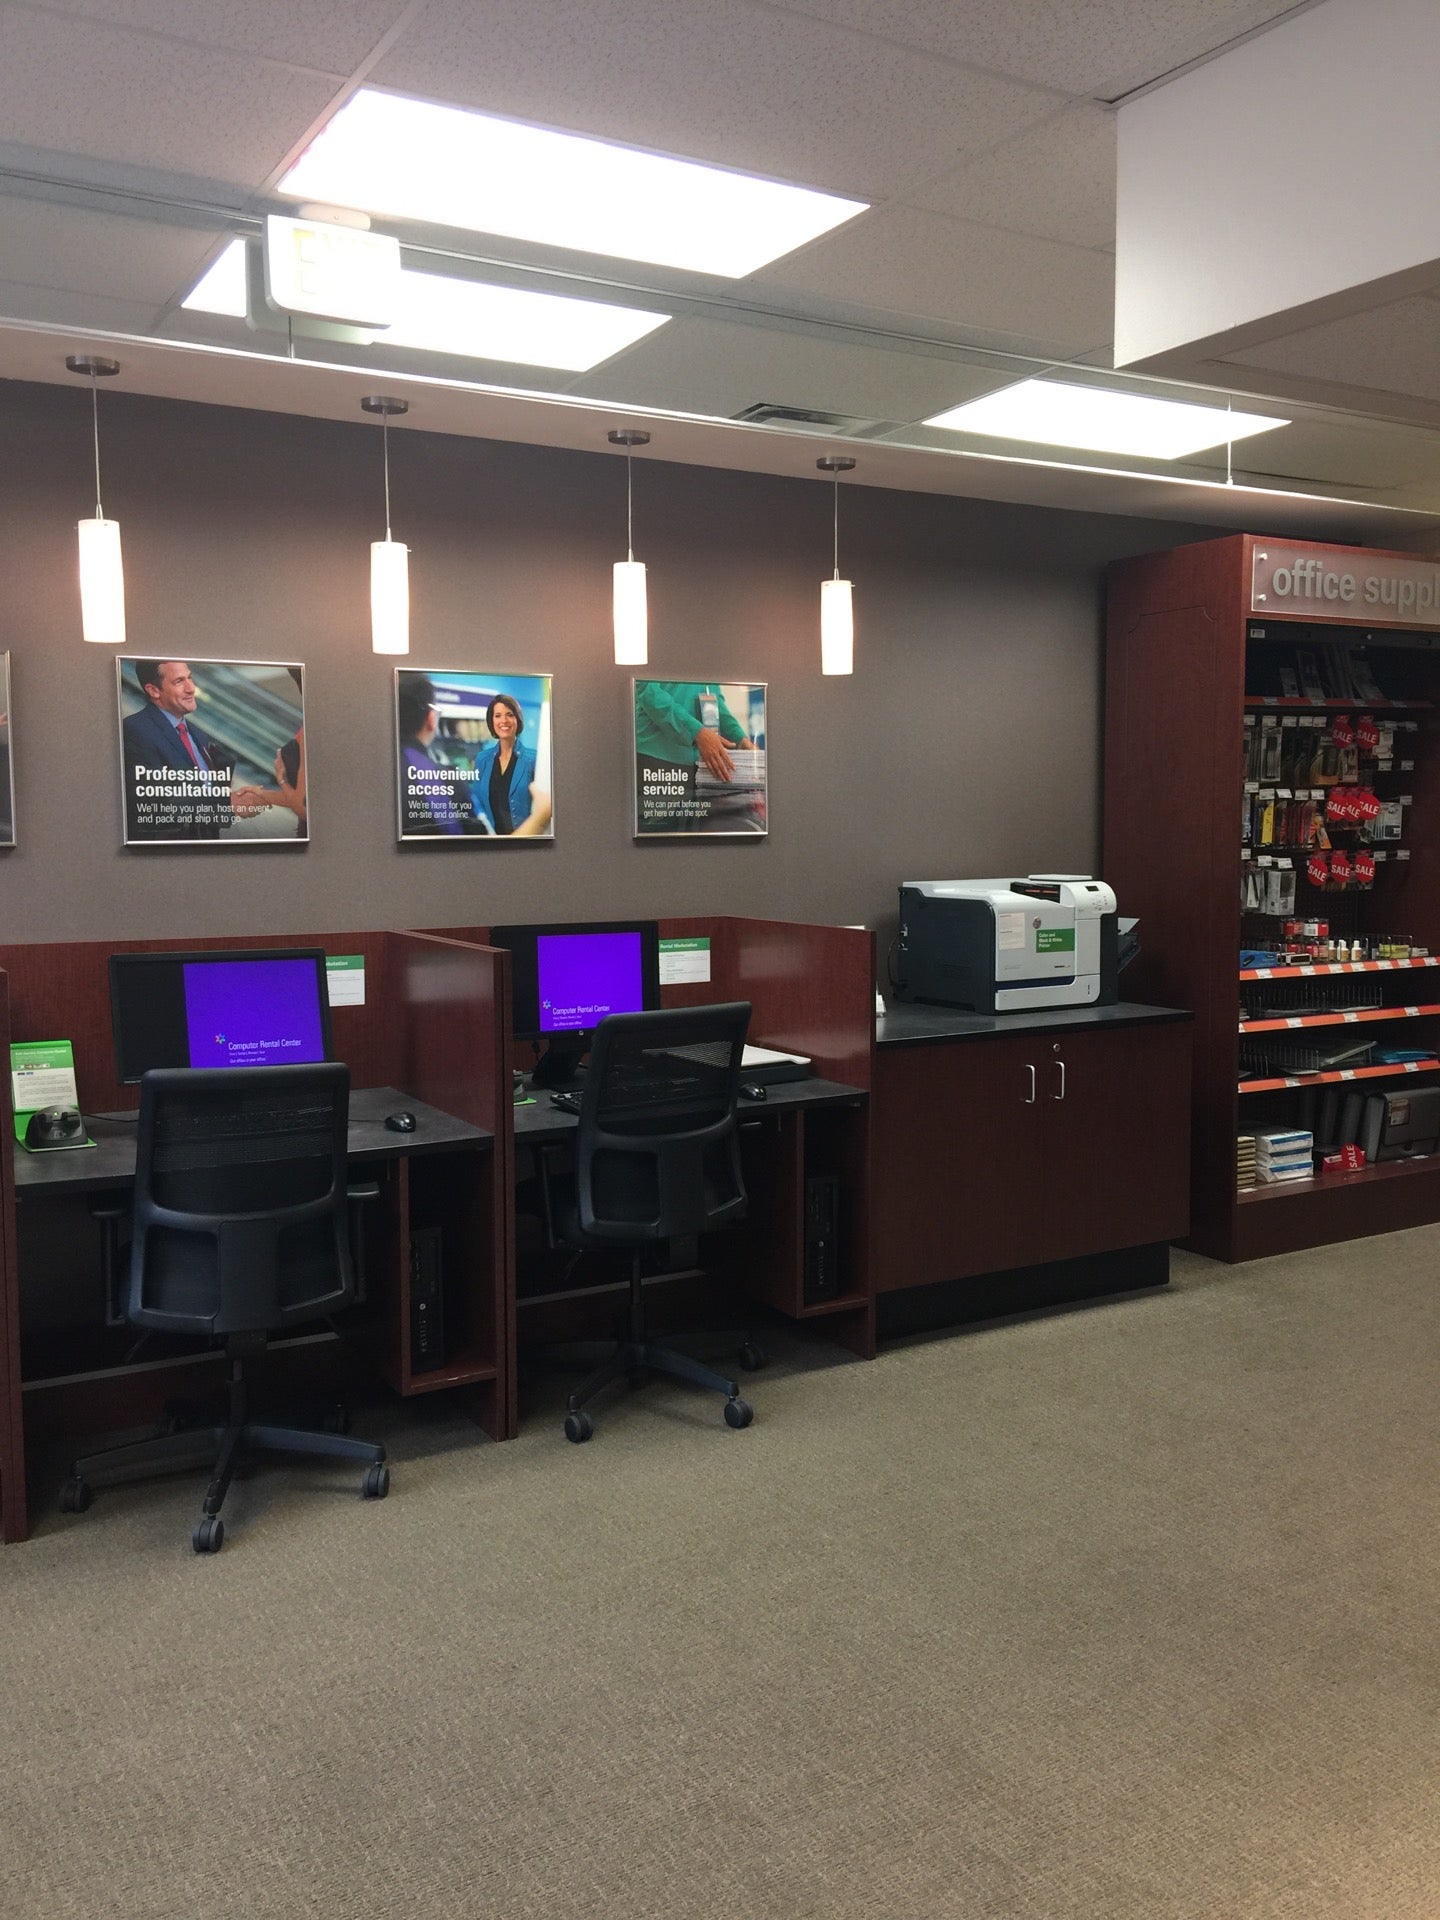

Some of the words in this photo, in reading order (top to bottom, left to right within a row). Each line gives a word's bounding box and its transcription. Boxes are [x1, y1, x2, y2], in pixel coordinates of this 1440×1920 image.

[1272, 558, 1356, 602] office
[1332, 729, 1353, 745] SALE
[1356, 729, 1378, 744] SALE
[135, 765, 231, 781] Professional
[407, 765, 480, 781] Convenient
[643, 768, 689, 782] Reliable
[135, 782, 232, 797] consultation
[407, 785, 455, 796] access
[643, 782, 685, 795] service
[136, 803, 158, 813] We'll
[160, 803, 178, 814] help
[179, 805, 194, 814] you
[196, 803, 215, 814] plan,
[217, 804, 235, 813] host
[236, 805, 247, 813] an
[408, 800, 430, 810] We're
[431, 800, 447, 810] here
[448, 801, 459, 810] for
[459, 802, 472, 811] you
[643, 800, 655, 808] We
[667, 800, 681, 809] print
[681, 800, 700, 808] before
[700, 801, 711, 809] you
[1327, 800, 1347, 816] SALE
[1346, 803, 1361, 818] ALE
[137, 814, 153, 823] and
[155, 814, 175, 824] pack
[177, 814, 192, 823] and
[194, 814, 211, 824] ship
[213, 814, 219, 823] it
[221, 815, 229, 823] to
[408, 809, 432, 819] on-site
[434, 809, 447, 818] and
[643, 810, 654, 818] get
[654, 808, 668, 817] here
[668, 809, 675, 817] or
[675, 809, 684, 817] on
[684, 809, 694, 817] the
[1307, 864, 1327, 882] SALE
[1331, 864, 1351, 878] SALE
[1355, 864, 1374, 878] SALE
[553, 1007, 577, 1016] Computer
[577, 1005, 593, 1014] Rental
[594, 1003, 610, 1013] Center
[228, 1042, 258, 1051] Computer
[260, 1039, 280, 1048] Rental
[281, 1038, 302, 1047] Center
[1346, 1144, 1358, 1168] SALE
